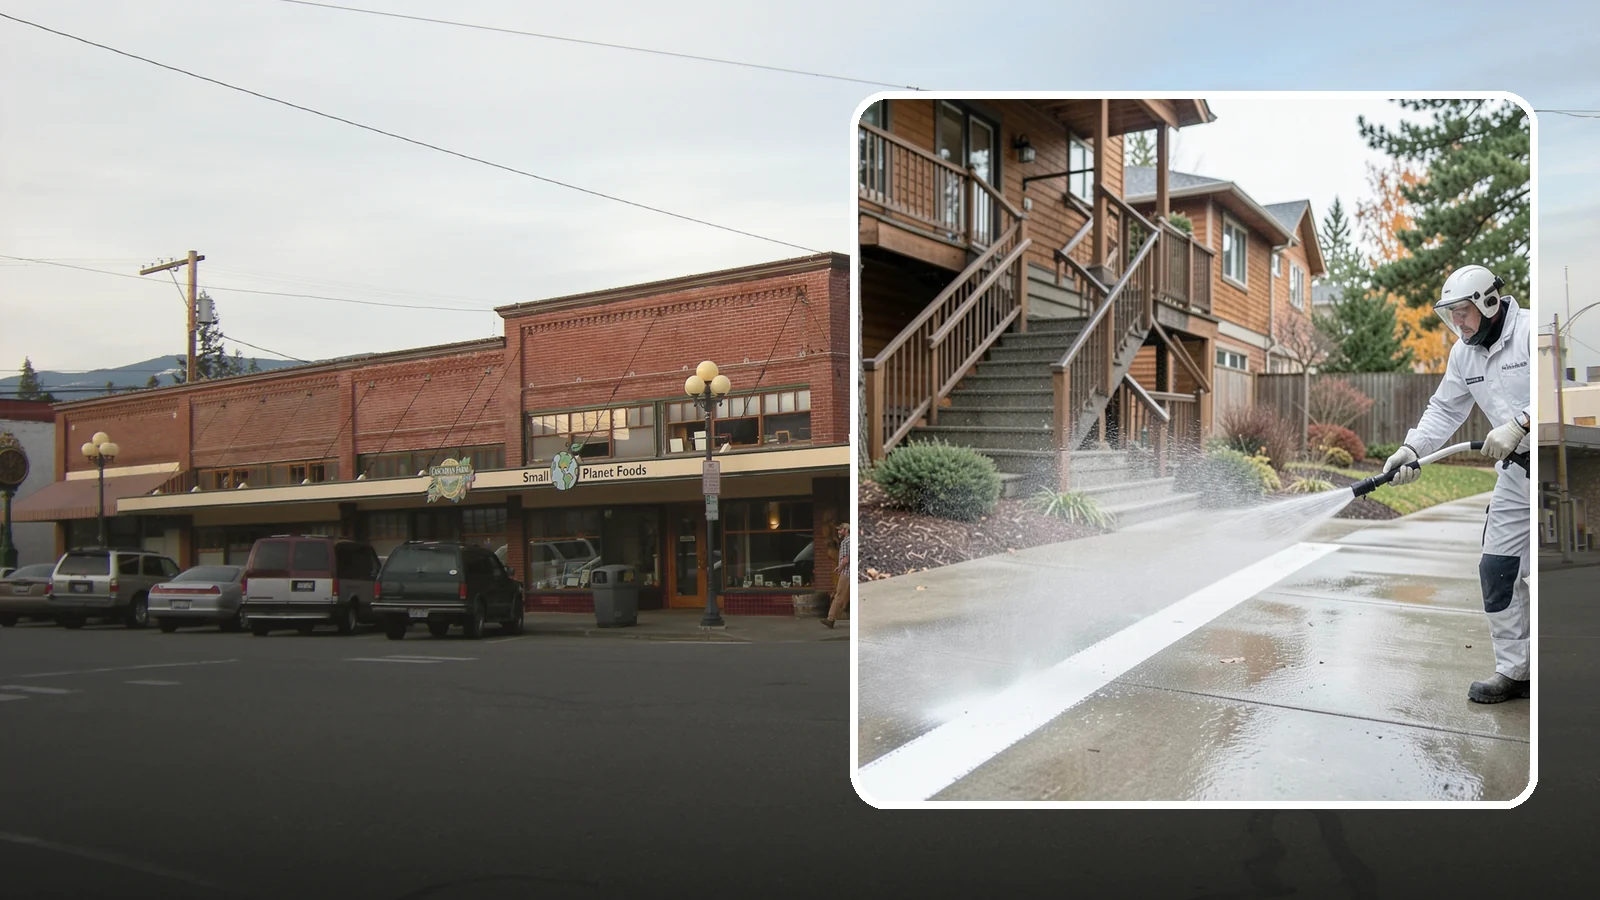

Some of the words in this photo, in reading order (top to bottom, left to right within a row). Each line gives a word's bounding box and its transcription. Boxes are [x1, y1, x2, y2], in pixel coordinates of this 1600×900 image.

[523, 471, 549, 483] Small
[583, 467, 614, 479] Planet
[617, 464, 647, 477] Foods
